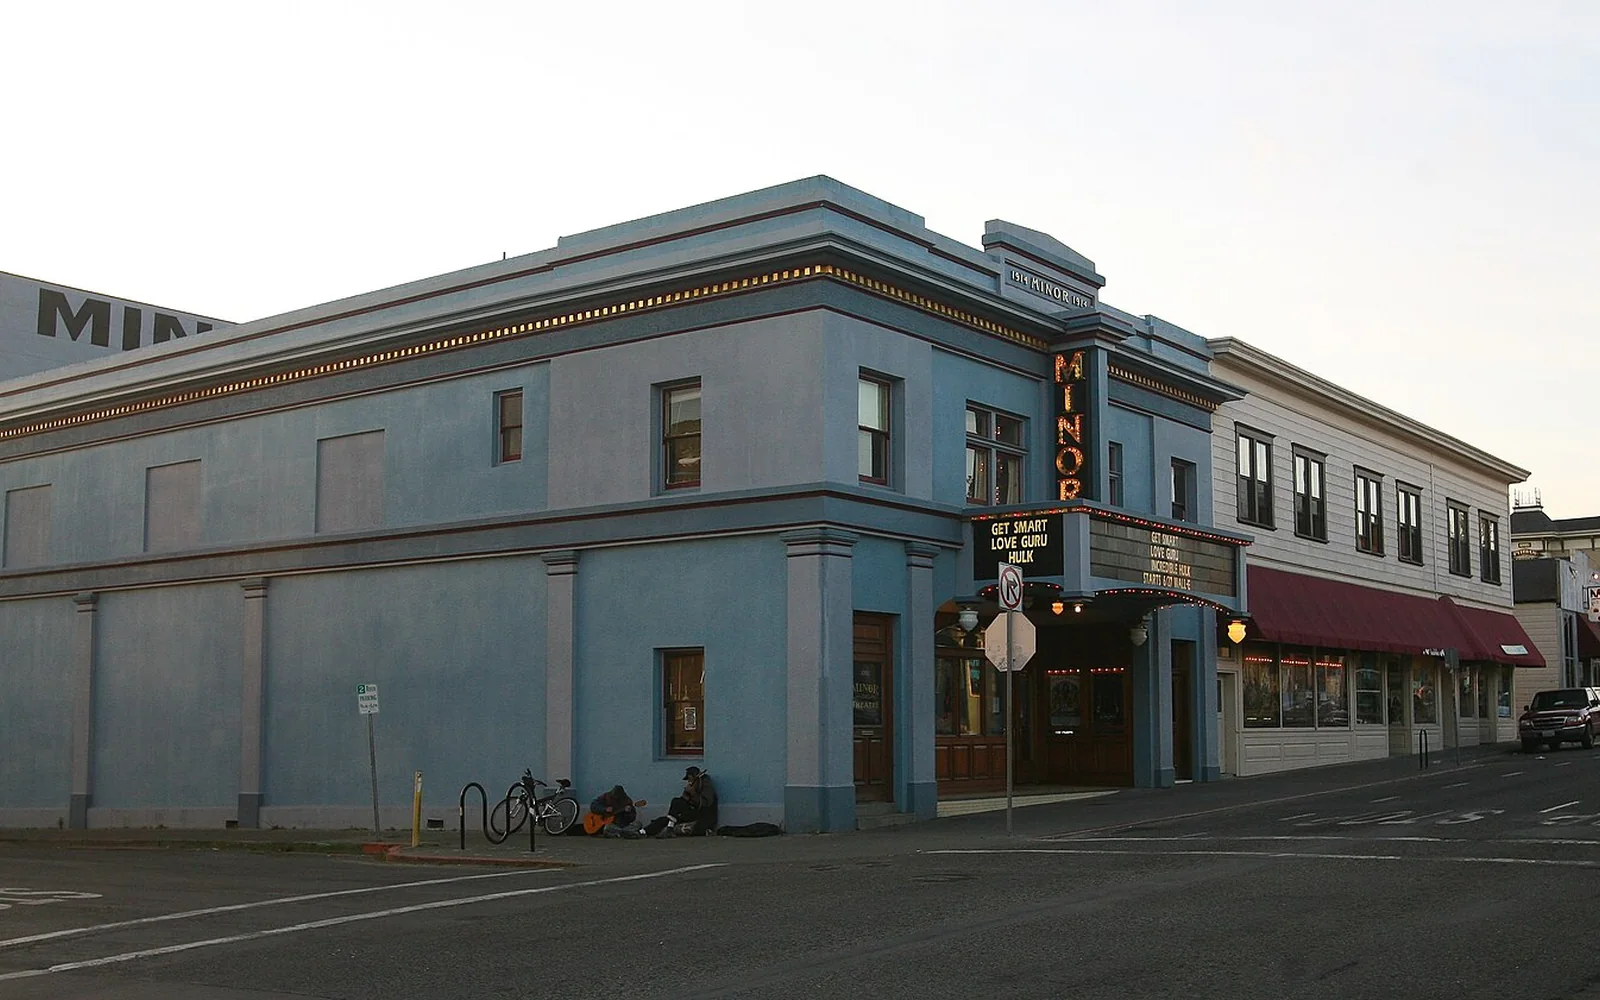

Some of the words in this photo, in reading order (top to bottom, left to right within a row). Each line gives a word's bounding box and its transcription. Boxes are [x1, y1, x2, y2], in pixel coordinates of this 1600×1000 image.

[1031, 277, 1070, 303] MINOR
[1055, 351, 1085, 501] MINOR
[991, 522, 1010, 536] GET
[1013, 519, 1048, 534] SMART
[991, 536, 1017, 550] LOVE
[1020, 533, 1048, 548] GURU
[1151, 531, 1161, 543] GET
[1008, 550, 1034, 564] HULK
